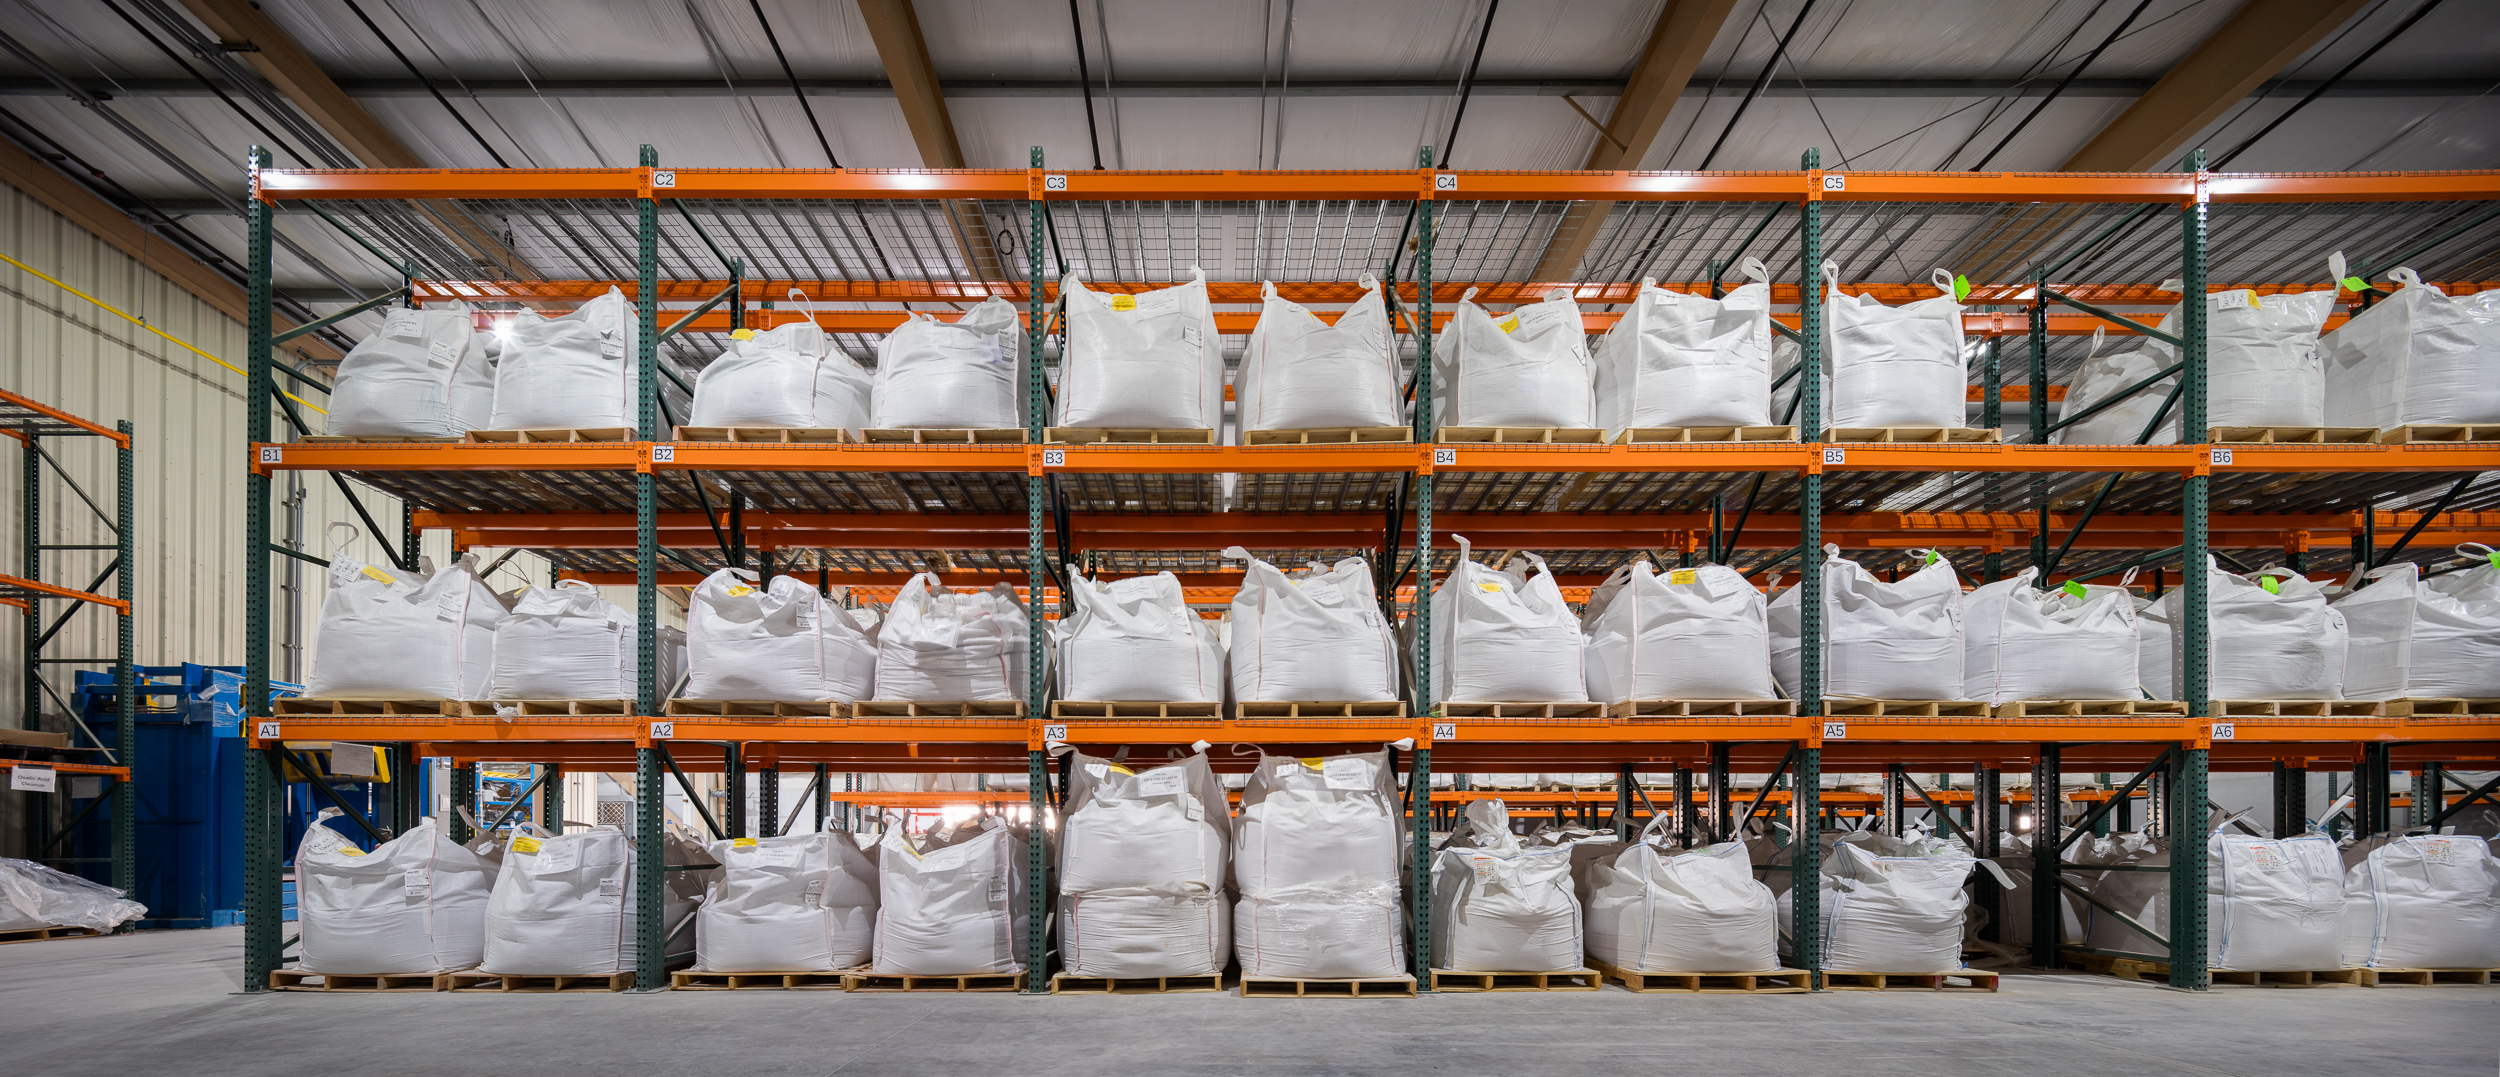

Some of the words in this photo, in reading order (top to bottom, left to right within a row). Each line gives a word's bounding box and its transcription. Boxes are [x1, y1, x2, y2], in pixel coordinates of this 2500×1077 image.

[655, 174, 674, 186] C2
[1047, 177, 1066, 189] C3
[1437, 177, 1456, 188] C4
[1825, 177, 1843, 189] C5
[262, 449, 280, 461] B1
[654, 449, 672, 460] B2
[1045, 452, 1063, 464] B3
[1436, 451, 1454, 463] B4
[1825, 451, 1843, 462] B5
[2213, 451, 2231, 463] B6
[260, 724, 280, 736] A1
[653, 724, 671, 736] A2
[1046, 727, 1065, 739] A3
[1435, 726, 1454, 738] A4
[1825, 725, 1844, 736] A5
[2213, 725, 2232, 737] A6
